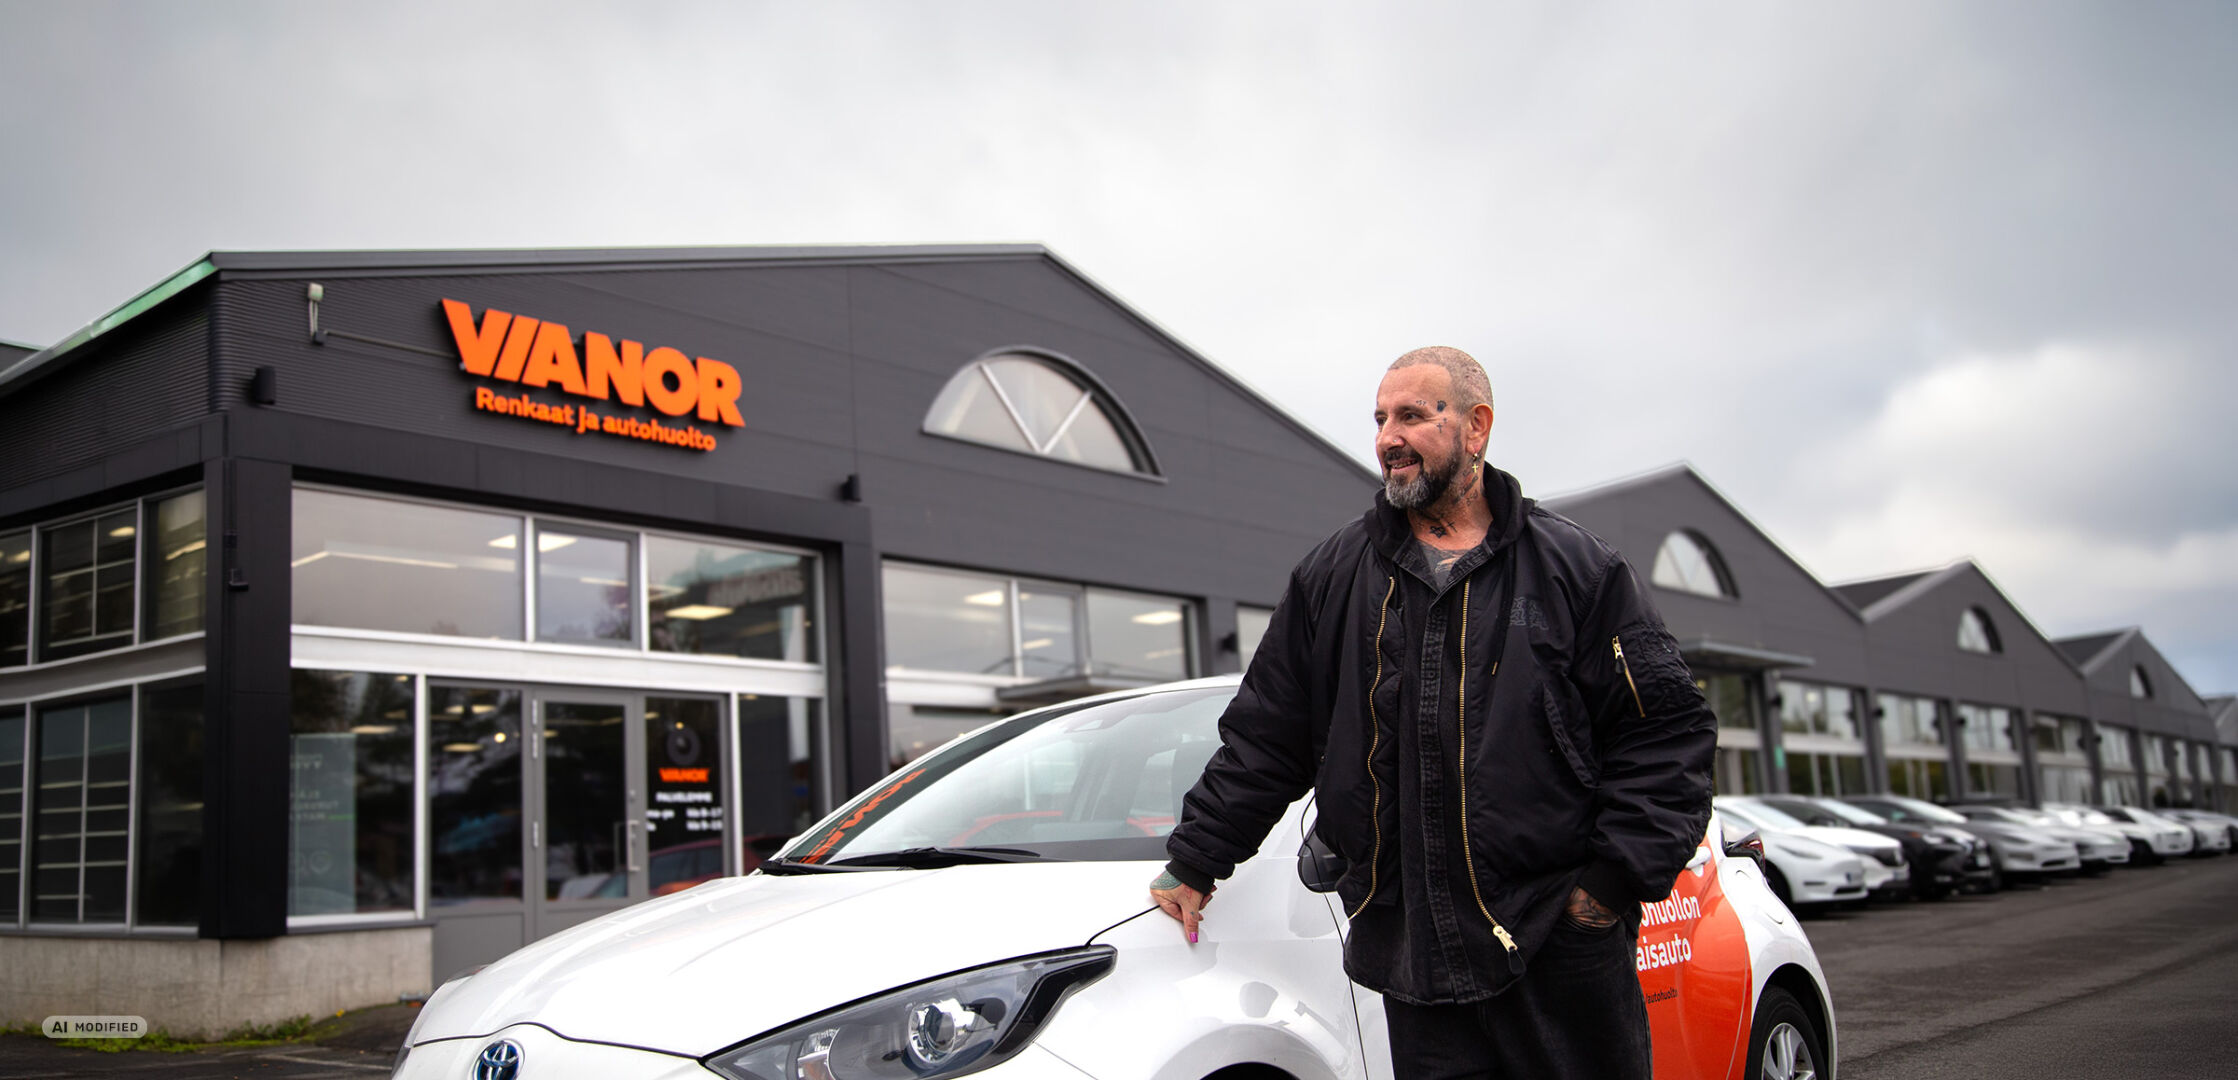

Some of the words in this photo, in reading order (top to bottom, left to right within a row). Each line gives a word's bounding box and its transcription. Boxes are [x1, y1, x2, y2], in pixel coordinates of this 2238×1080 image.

[442, 298, 745, 427] VIANOR
[476, 386, 575, 426] Renkaat
[577, 405, 600, 435] ja
[602, 414, 717, 452] autohuolto
